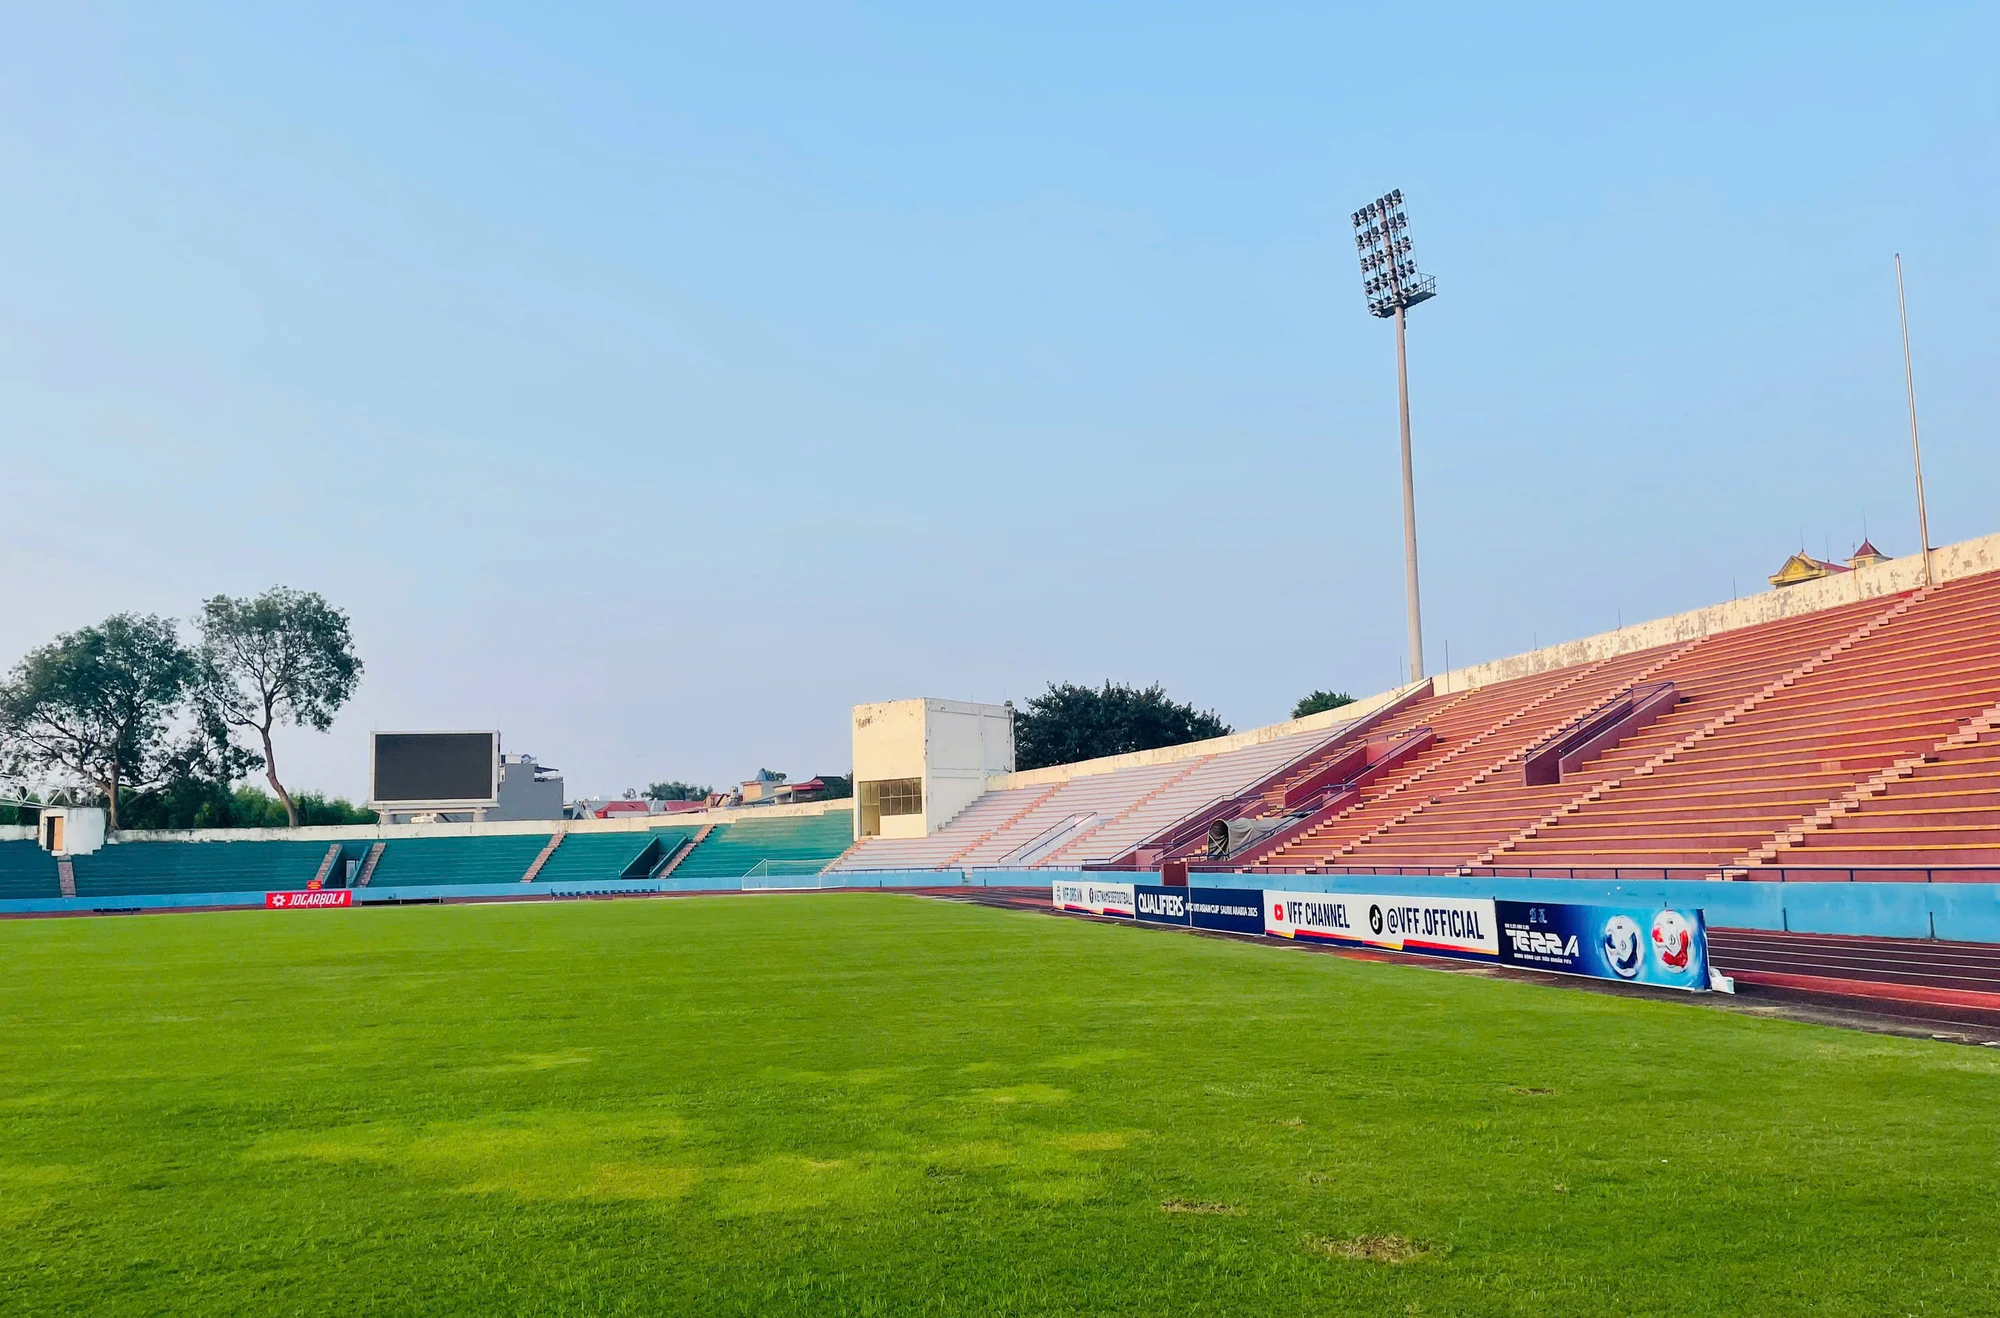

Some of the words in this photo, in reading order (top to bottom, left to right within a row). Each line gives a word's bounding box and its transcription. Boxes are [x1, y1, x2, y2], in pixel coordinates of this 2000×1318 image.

[288, 892, 345, 906] JOGARBOLA
[1138, 892, 1185, 917] QUALIFIERS
[1211, 904, 1220, 914] CUP
[1221, 905, 1233, 915] SAUDI
[1247, 907, 1258, 917] 2025
[1286, 901, 1303, 924] VFF
[1305, 902, 1350, 928] CHANNEL
[1387, 906, 1485, 940] @VFF.OFFICIAL
[1505, 929, 1580, 957] TERRA
